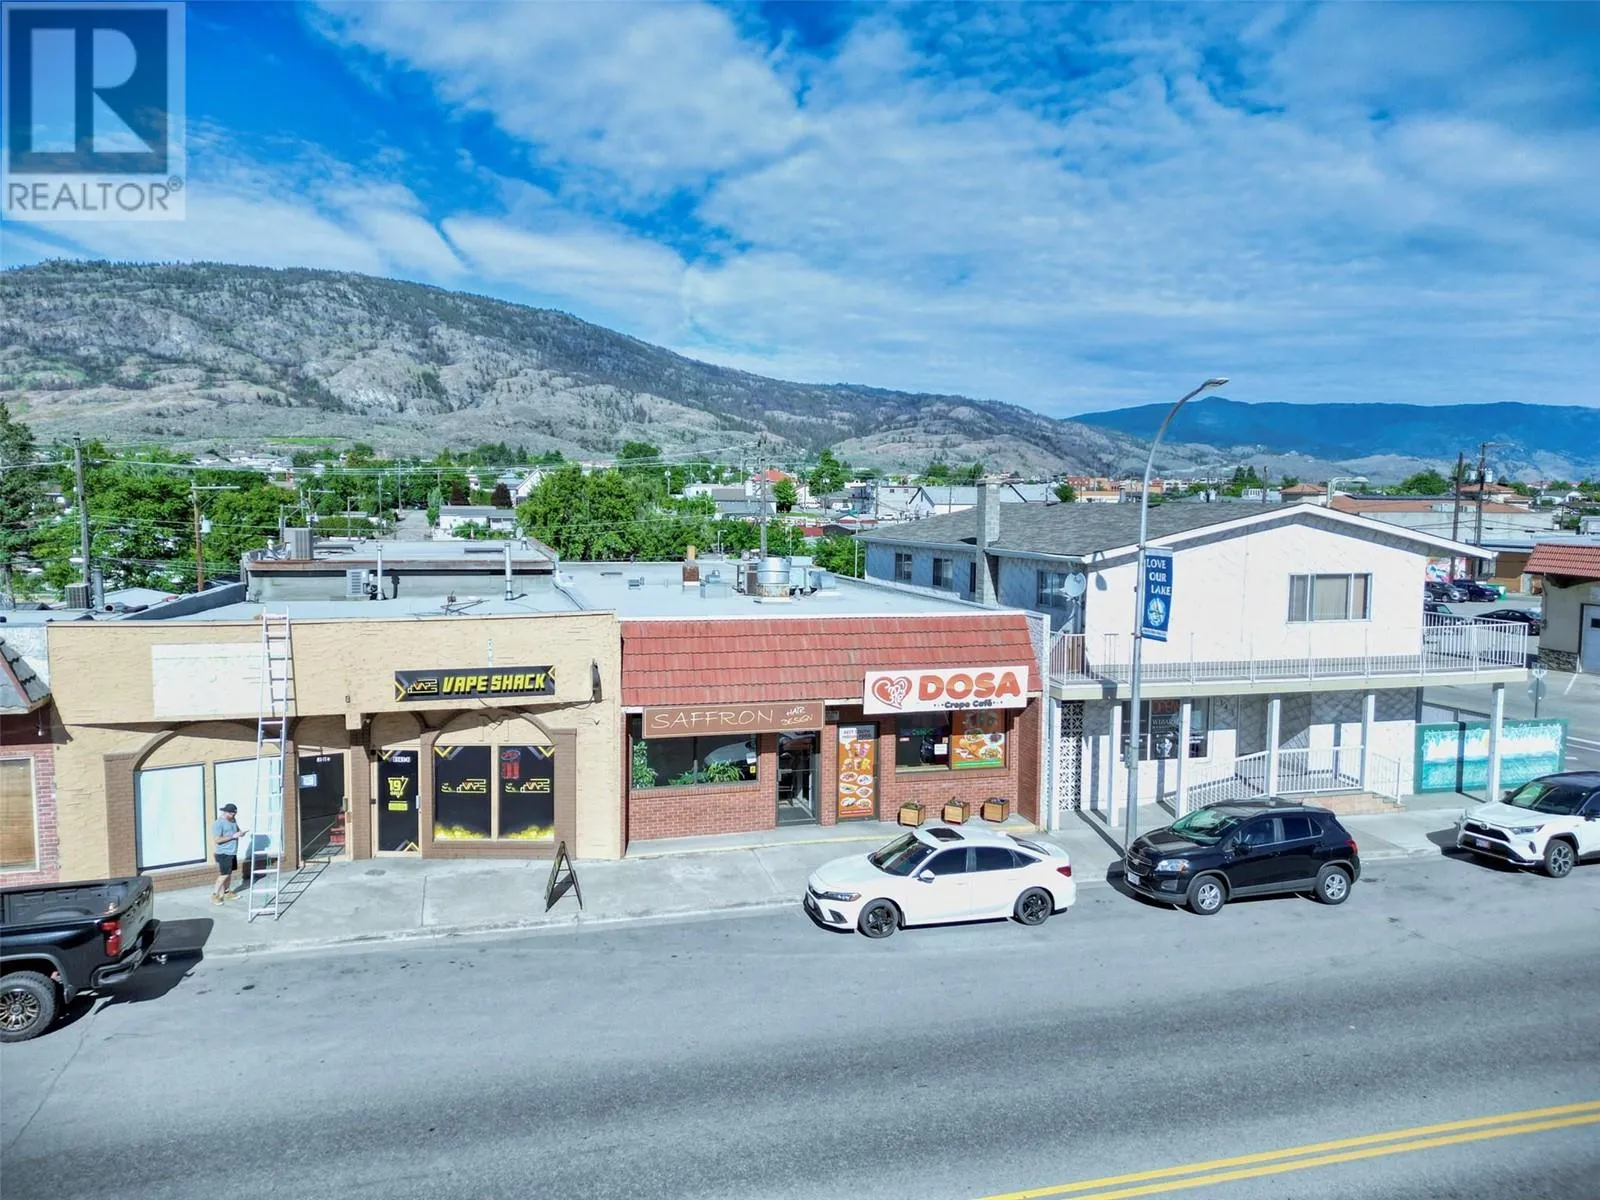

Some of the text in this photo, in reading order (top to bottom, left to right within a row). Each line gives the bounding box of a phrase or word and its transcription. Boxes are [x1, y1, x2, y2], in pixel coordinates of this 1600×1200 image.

[1146, 558, 1167, 569] LOVE
[1149, 571, 1167, 582] OUR
[1151, 584, 1171, 596] LAKE
[442, 673, 547, 694] VAPE SHACK
[918, 671, 1021, 701] DOSA
[944, 701, 970, 710] Crepe
[650, 709, 774, 729] SAFFRON
[780, 714, 814, 725] DESIGN
